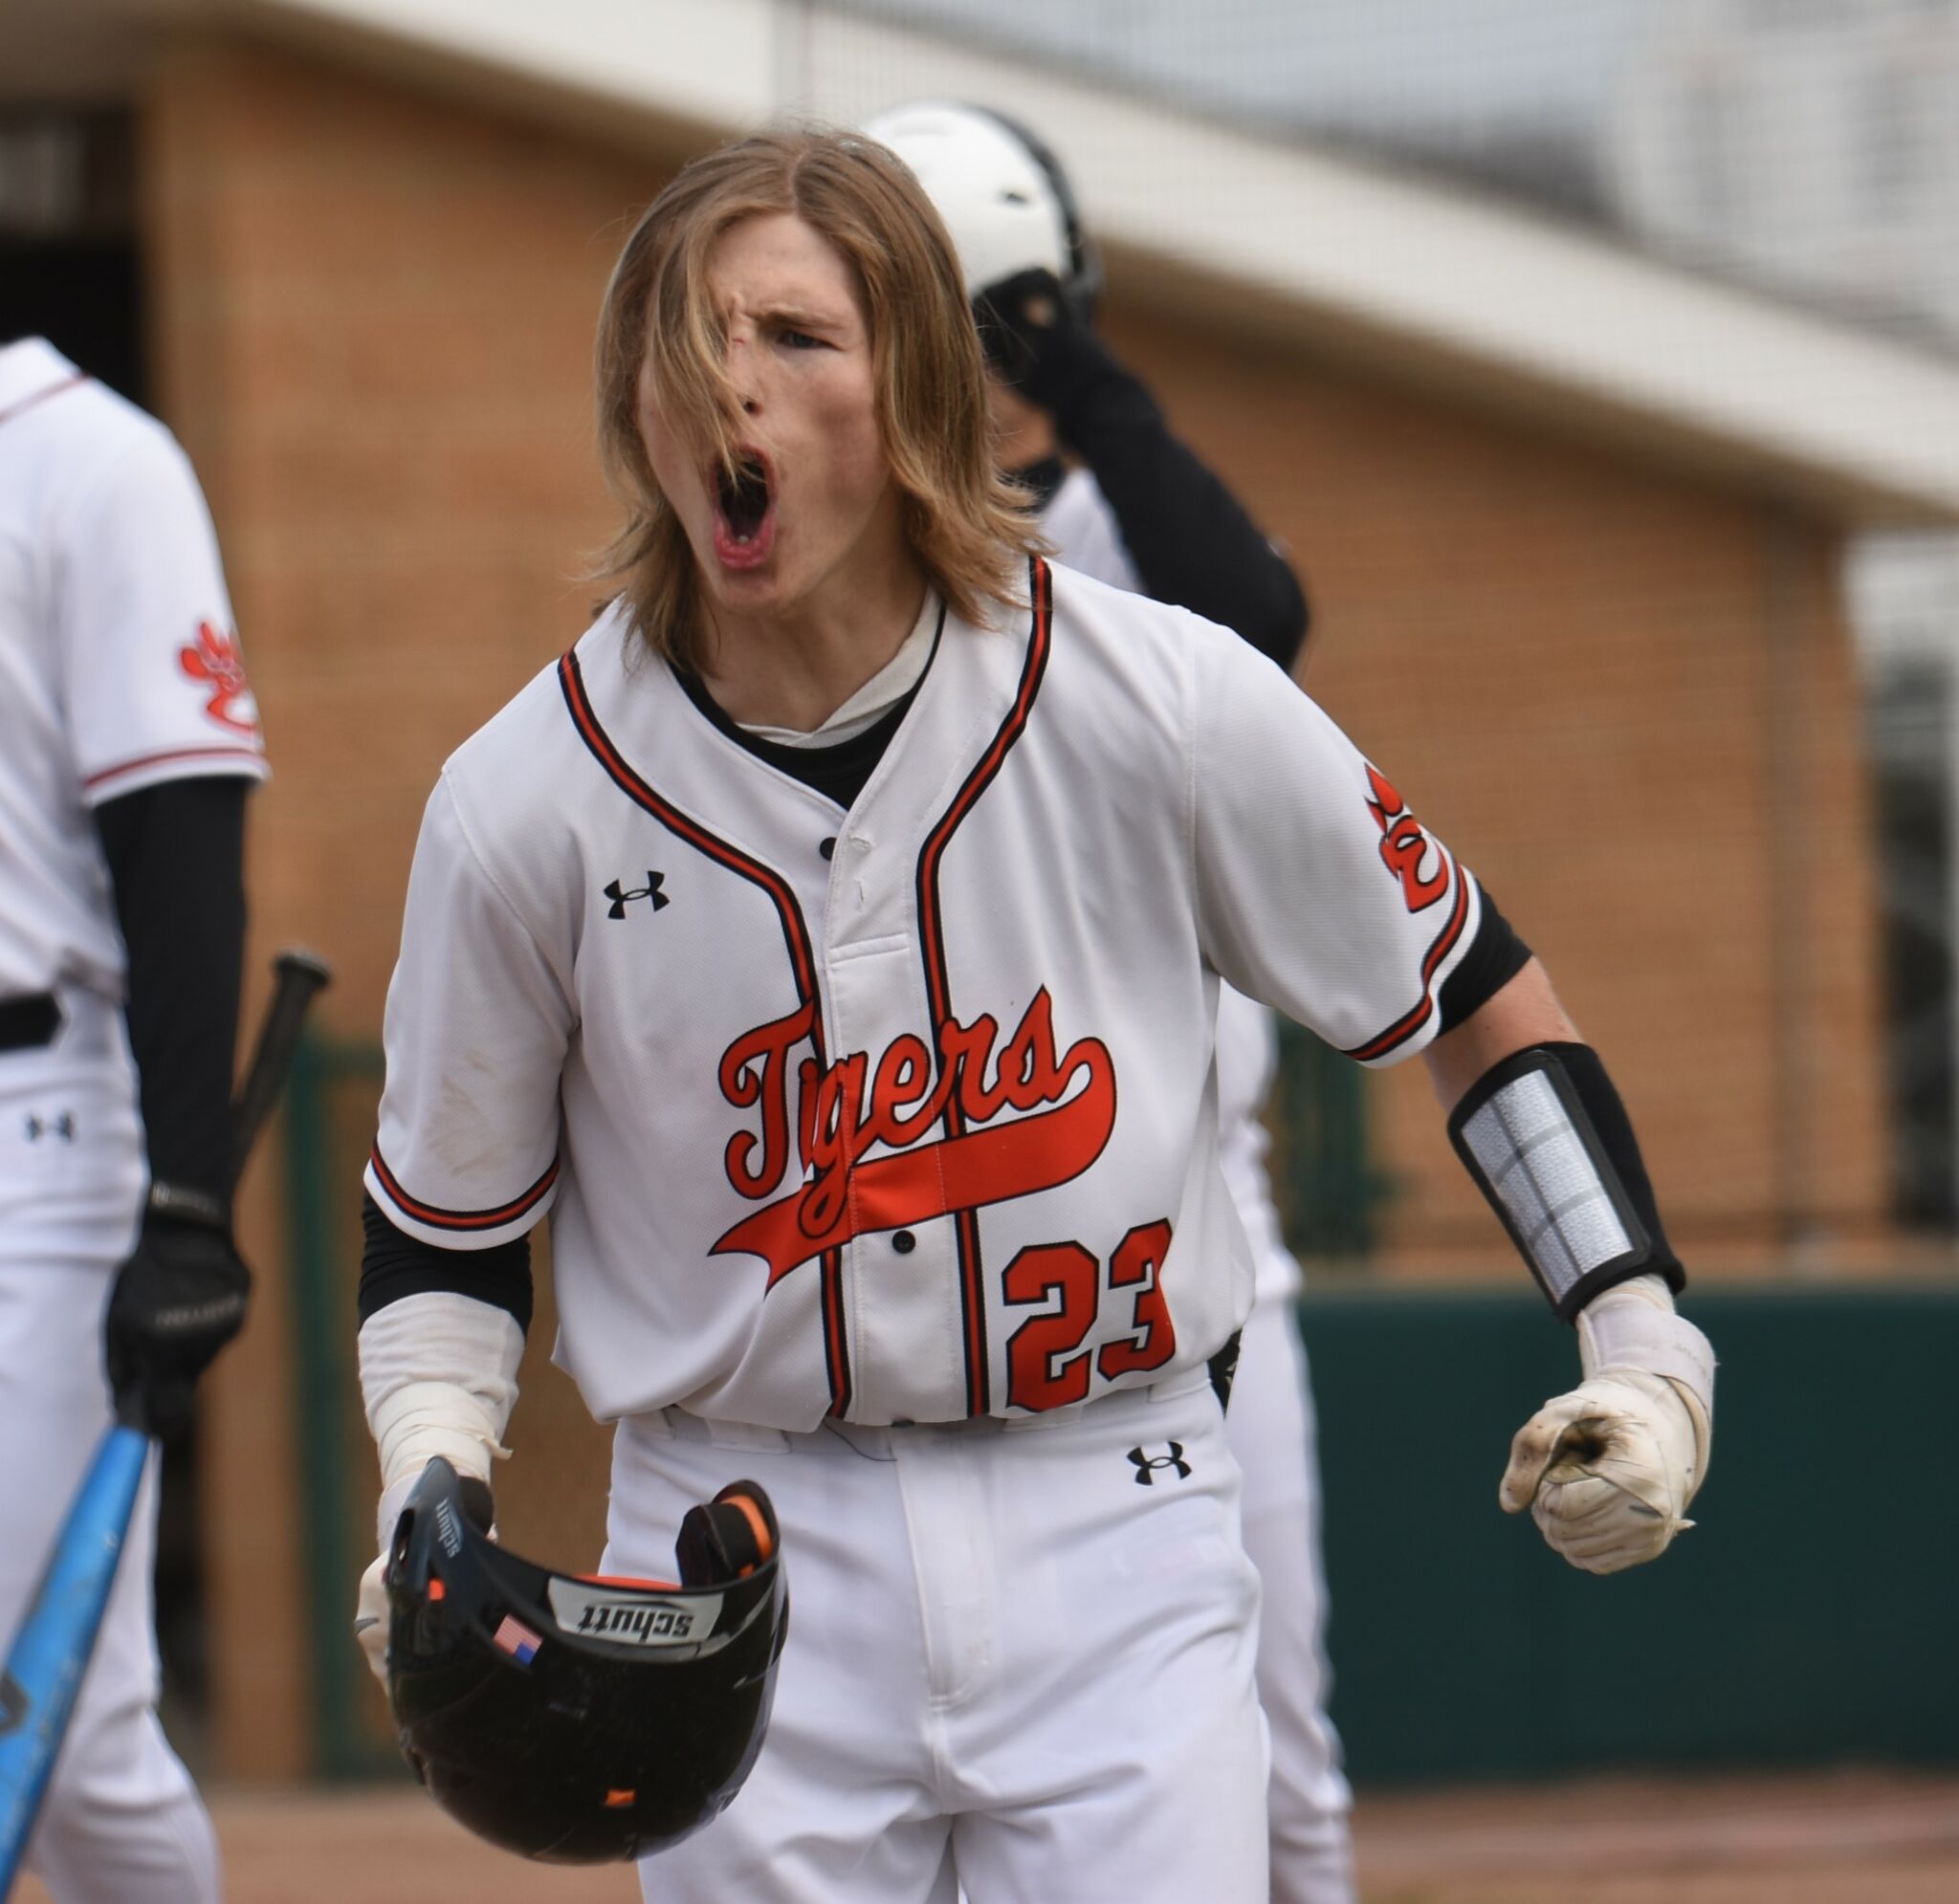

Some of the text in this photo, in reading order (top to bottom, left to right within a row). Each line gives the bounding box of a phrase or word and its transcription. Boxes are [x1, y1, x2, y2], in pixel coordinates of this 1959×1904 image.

[717, 983, 1062, 1240] Tigers
[1002, 1217, 1178, 1413] 23
[577, 1606, 694, 1643] schutt
